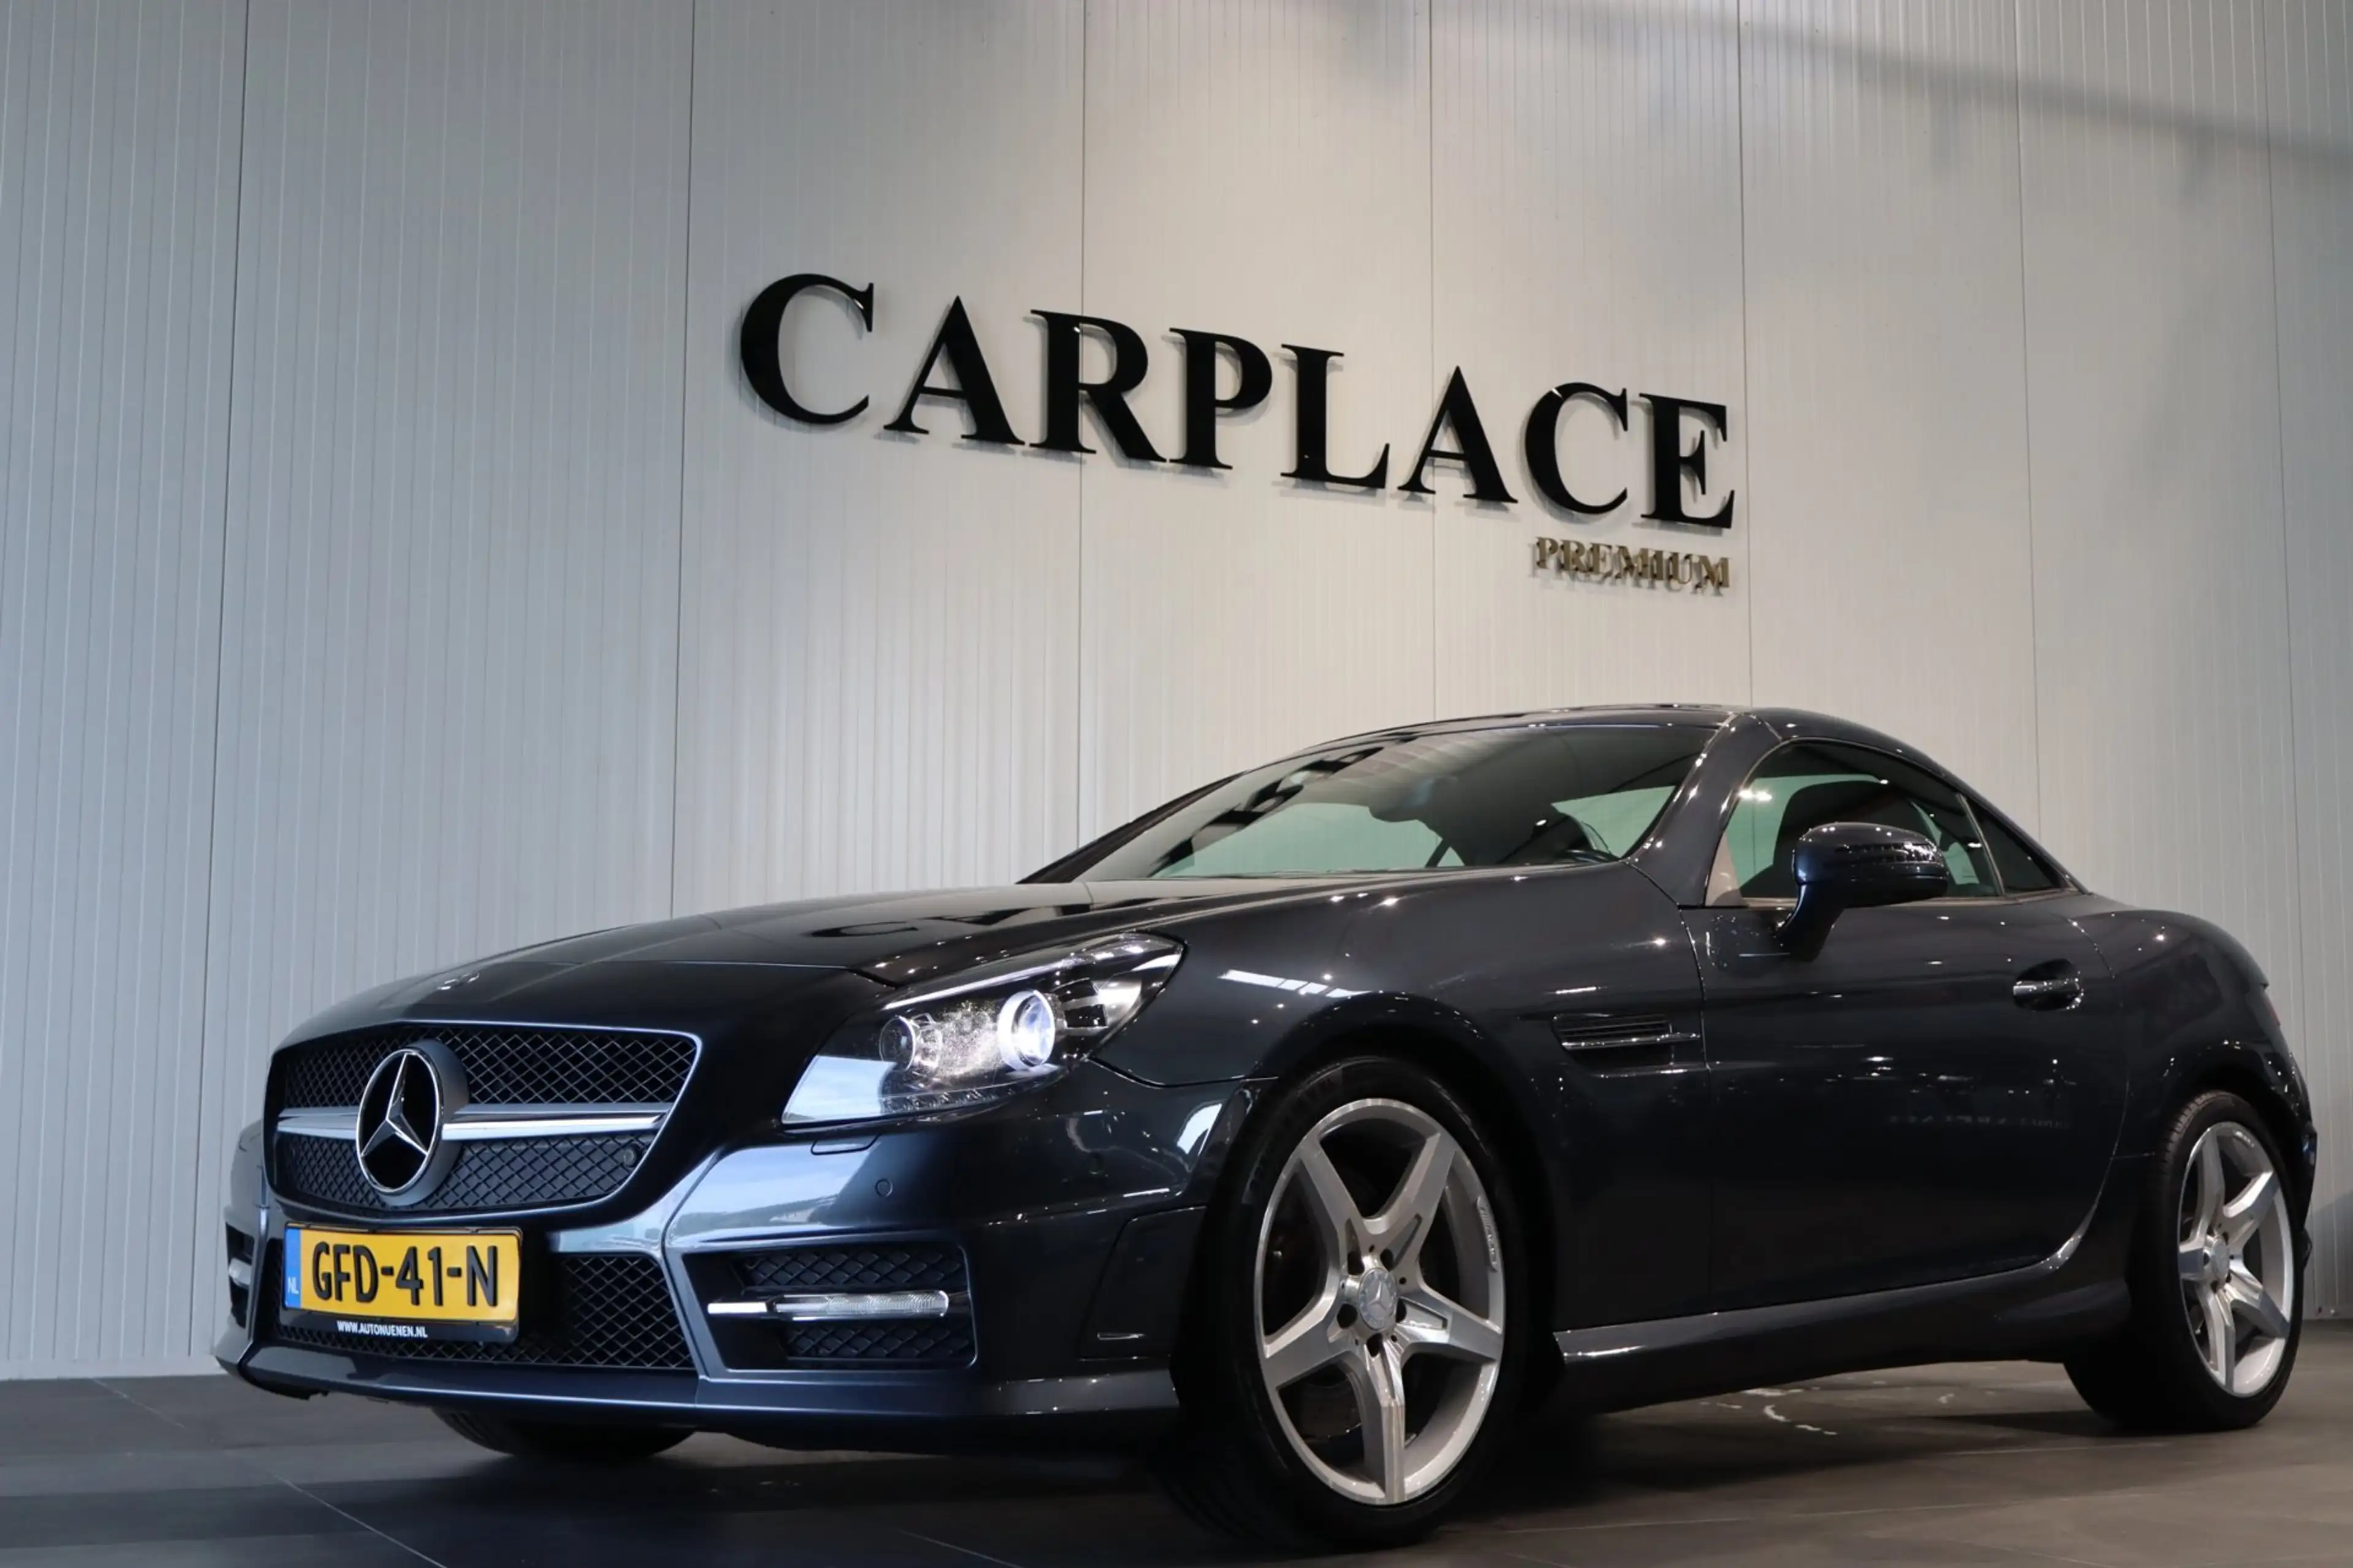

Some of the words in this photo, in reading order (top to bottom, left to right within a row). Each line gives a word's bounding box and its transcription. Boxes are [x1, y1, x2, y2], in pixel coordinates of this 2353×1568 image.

[740, 274, 1734, 529] CARPLACE
[1535, 536, 1732, 588] PREMIUM
[287, 1277, 300, 1295] NL
[313, 1241, 498, 1306] GFD-41-N
[336, 1320, 428, 1338] WWW.AUTONUENEN.NL
